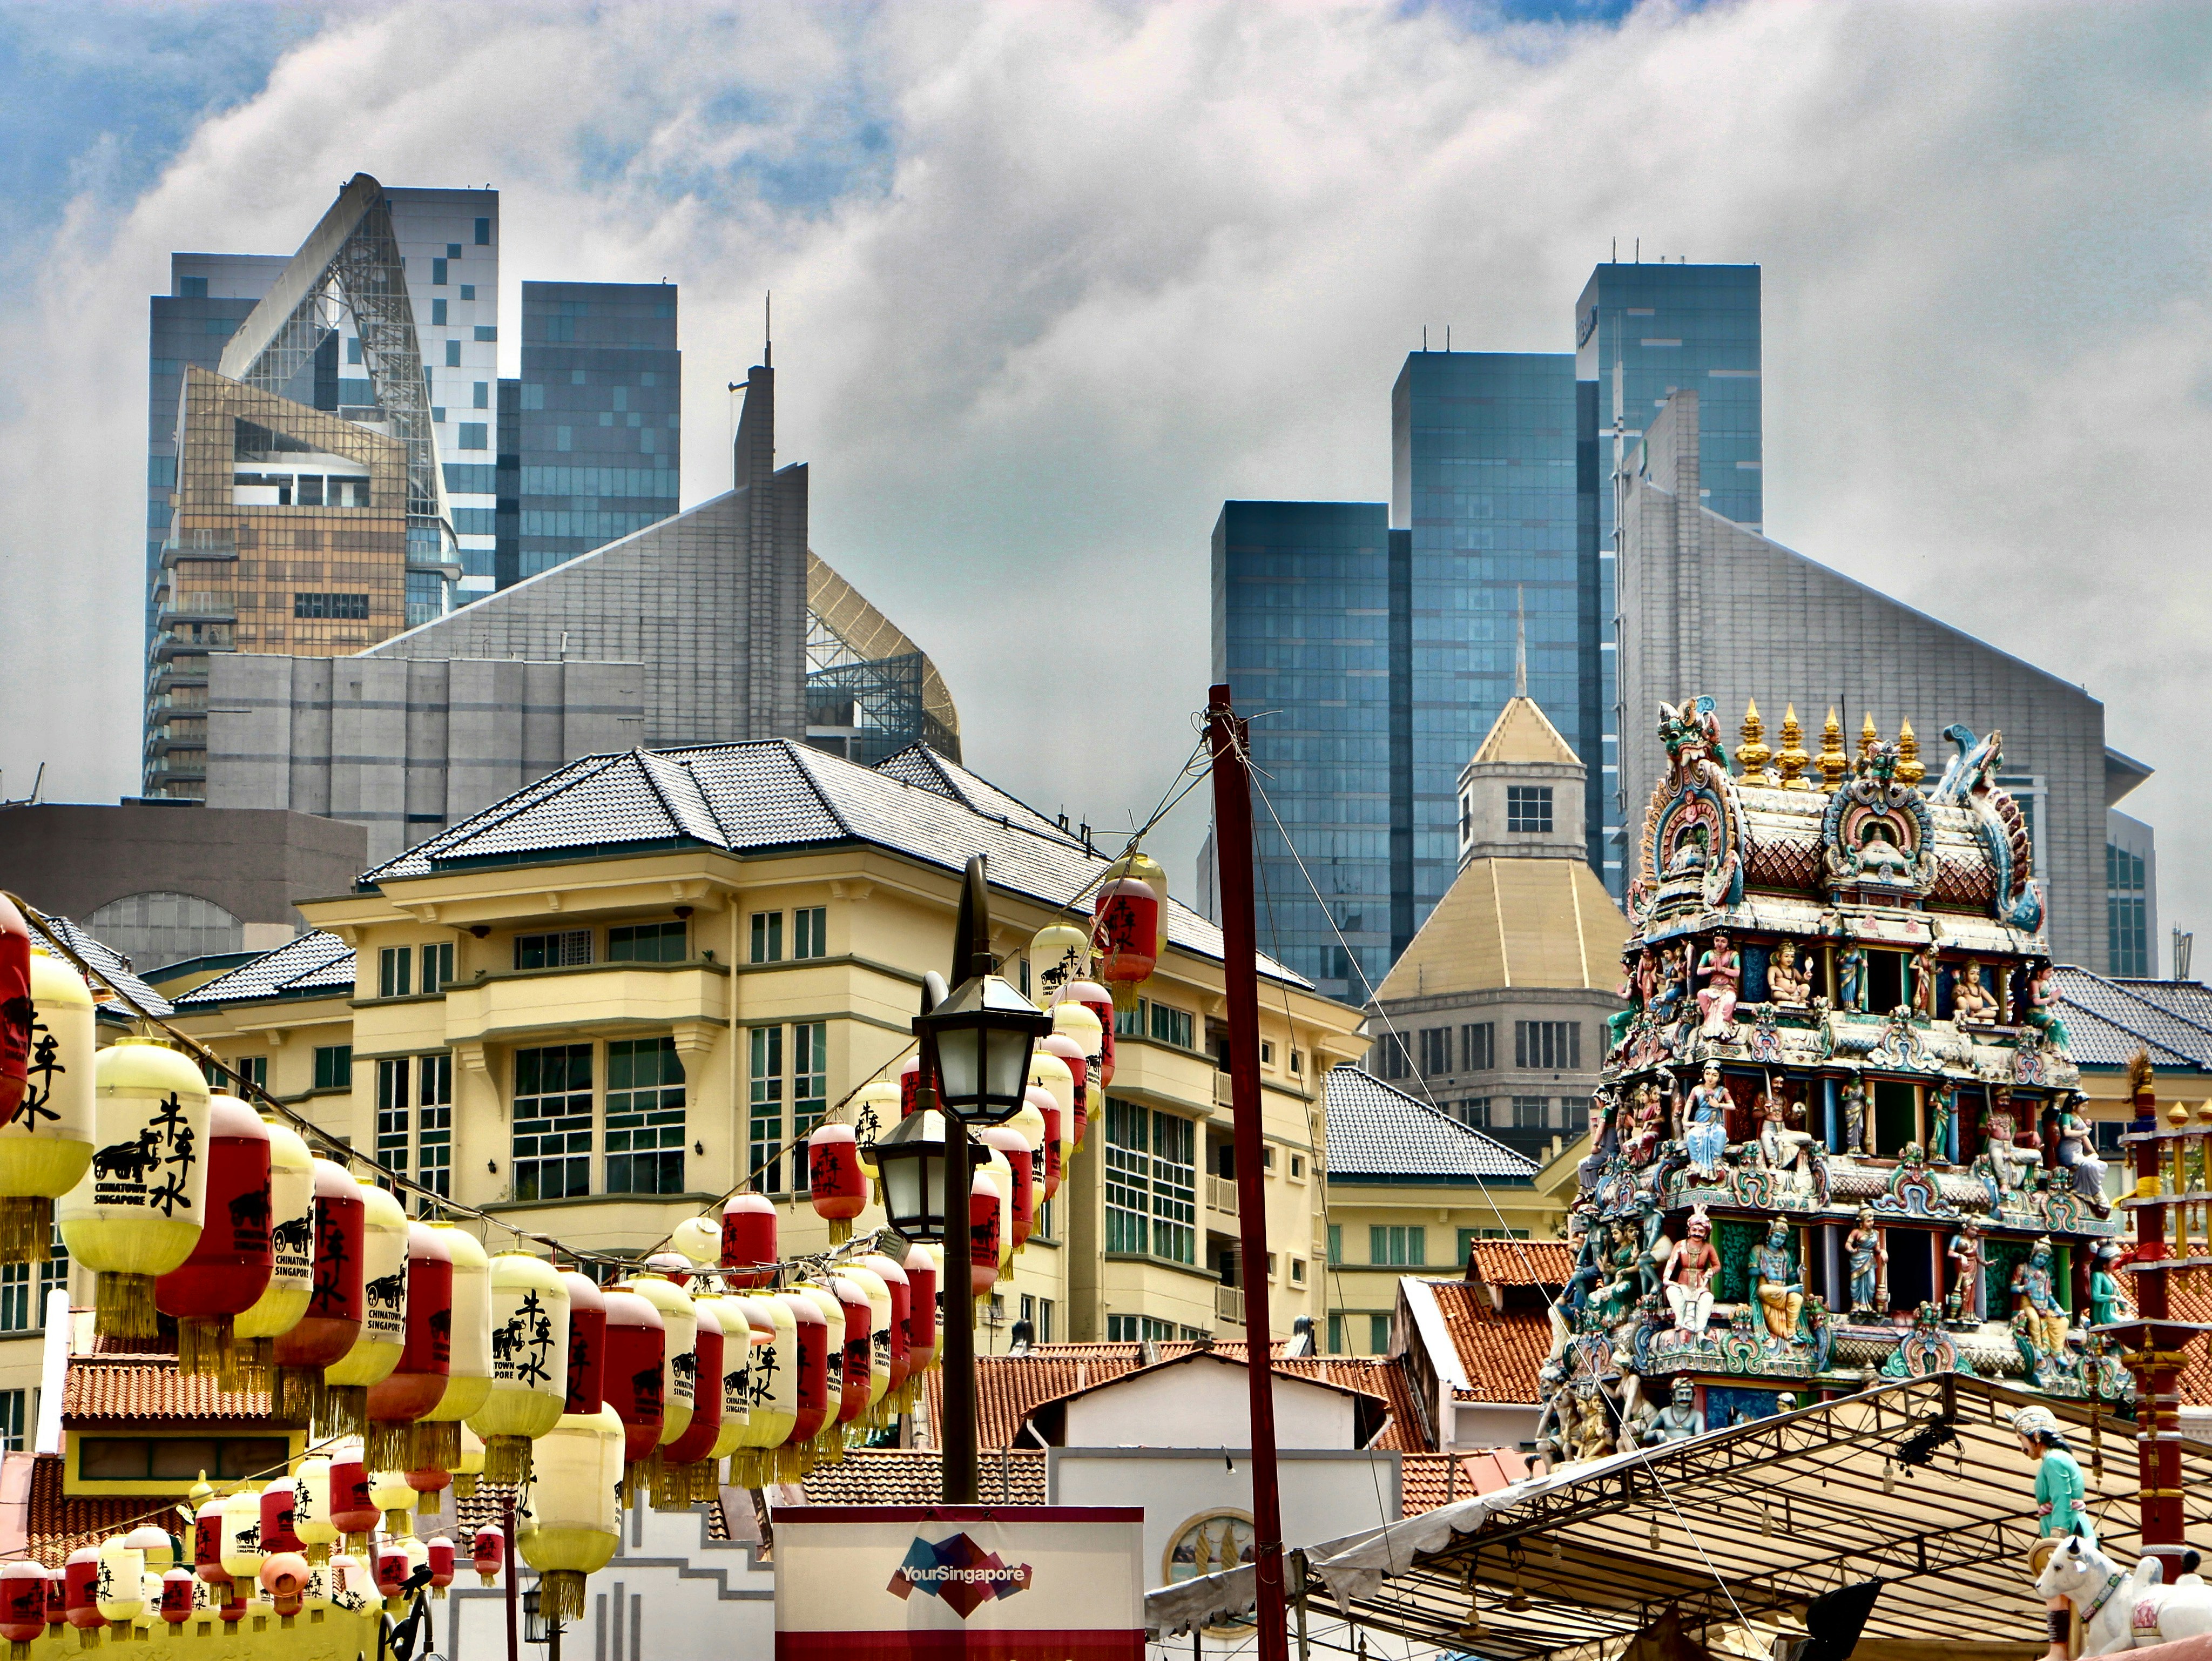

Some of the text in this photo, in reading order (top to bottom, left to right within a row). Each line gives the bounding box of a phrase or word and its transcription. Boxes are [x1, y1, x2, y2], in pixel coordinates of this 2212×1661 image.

[149, 1092, 196, 1218] 牛车水
[95, 1183, 147, 1194] CHINATOWN
[94, 1195, 145, 1206] SINGAPORE
[275, 1255, 309, 1267] CHINATOWN
[275, 1267, 309, 1279] SINGAPORE
[367, 1320, 401, 1333] SINGAPORE
[368, 1309, 402, 1321] CHINATOWN
[515, 1289, 555, 1389] 牛车水
[749, 1342, 780, 1408] 车水
[294, 1478, 312, 1524] 牛车水
[99, 1558, 114, 1602] 牛车水
[311, 1570, 323, 1598] 牛车水
[901, 1565, 1025, 1584] YourSingapore
[195, 1582, 207, 1610] 牛车水
